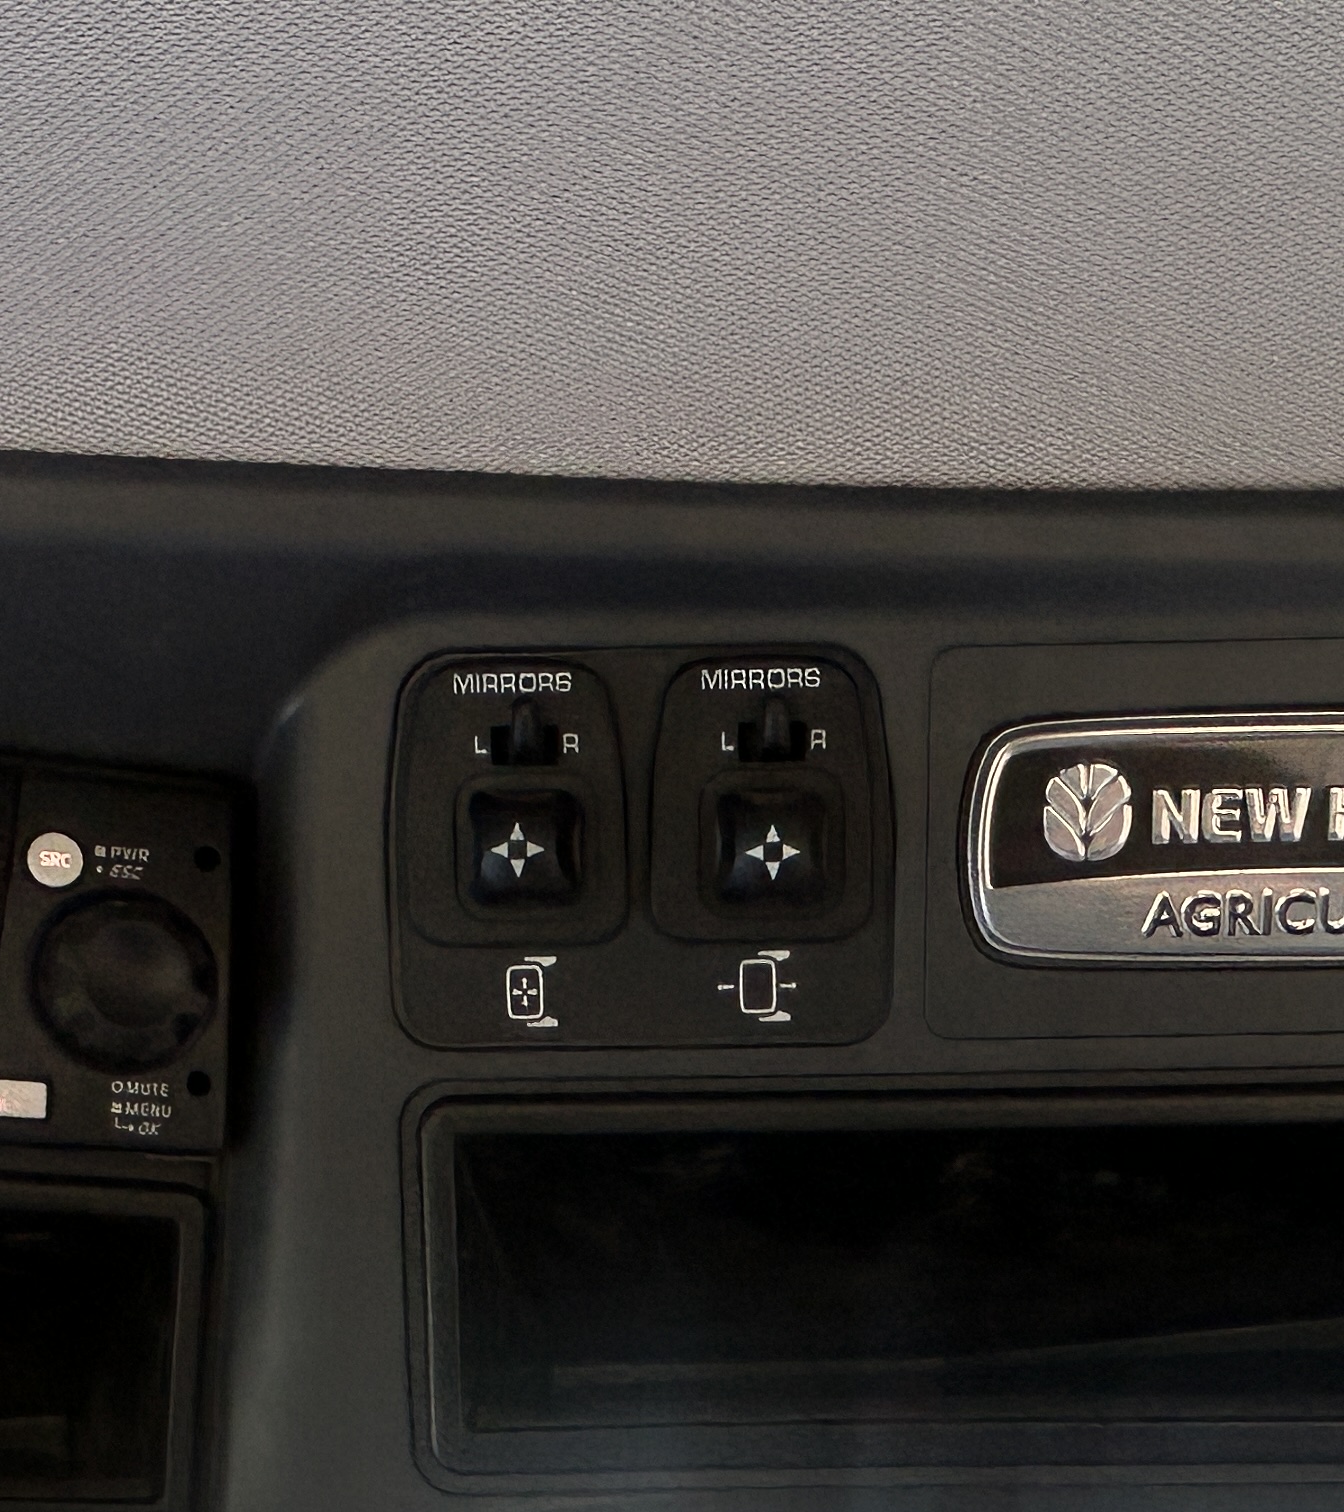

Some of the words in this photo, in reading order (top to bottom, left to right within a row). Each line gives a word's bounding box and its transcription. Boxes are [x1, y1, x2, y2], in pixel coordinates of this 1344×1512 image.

[453, 672, 572, 694] MIRRORS
[701, 667, 821, 690] MIRRORS
[474, 735, 487, 755] L
[563, 733, 579, 753] R
[721, 730, 734, 751] L
[811, 730, 827, 750] R
[1151, 785, 1311, 846] NEW
[39, 850, 72, 869] SRC
[110, 846, 150, 863] PWR
[127, 1082, 170, 1098] MUTE
[126, 1102, 172, 1118] MENU
